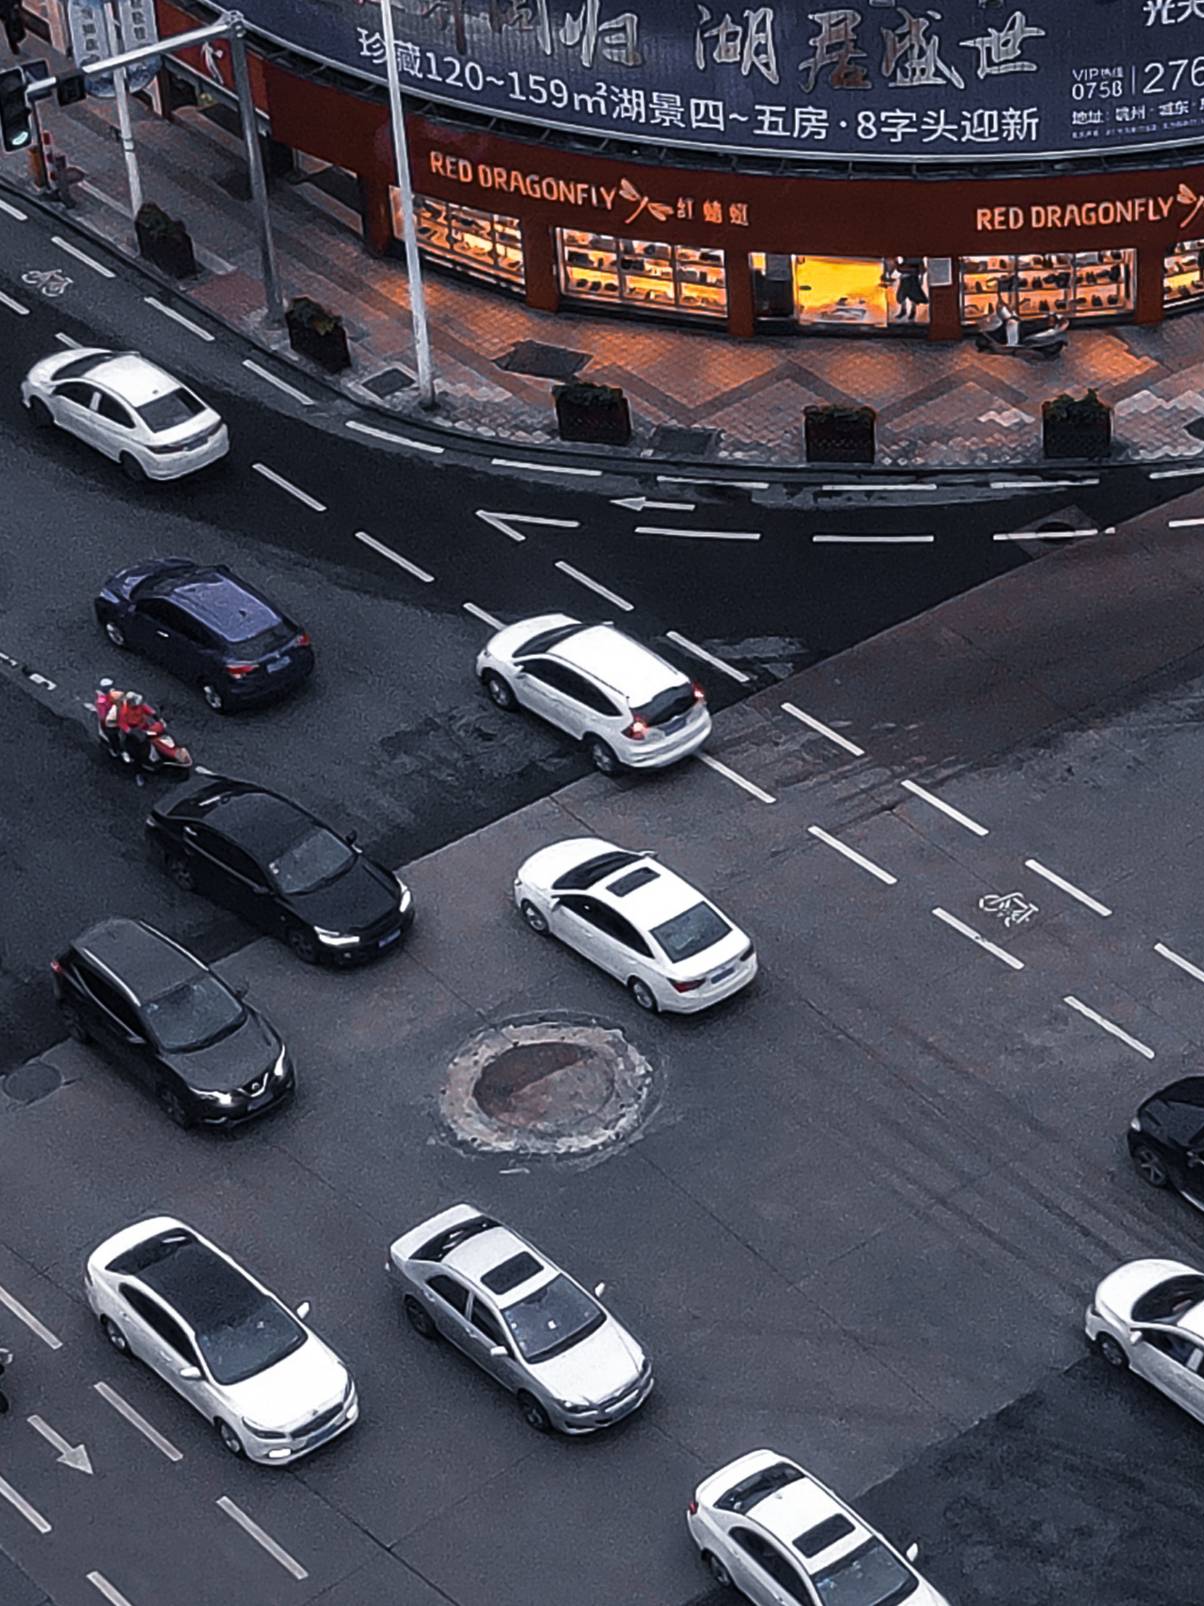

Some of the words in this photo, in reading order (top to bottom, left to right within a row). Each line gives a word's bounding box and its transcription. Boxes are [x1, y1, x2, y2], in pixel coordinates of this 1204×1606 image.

[1072, 80, 1123, 100] 0758
[430, 150, 473, 184] RED
[478, 165, 617, 211] DRAGONFLY
[976, 206, 1024, 232] RED
[1031, 196, 1175, 230] DRAGONFLY
